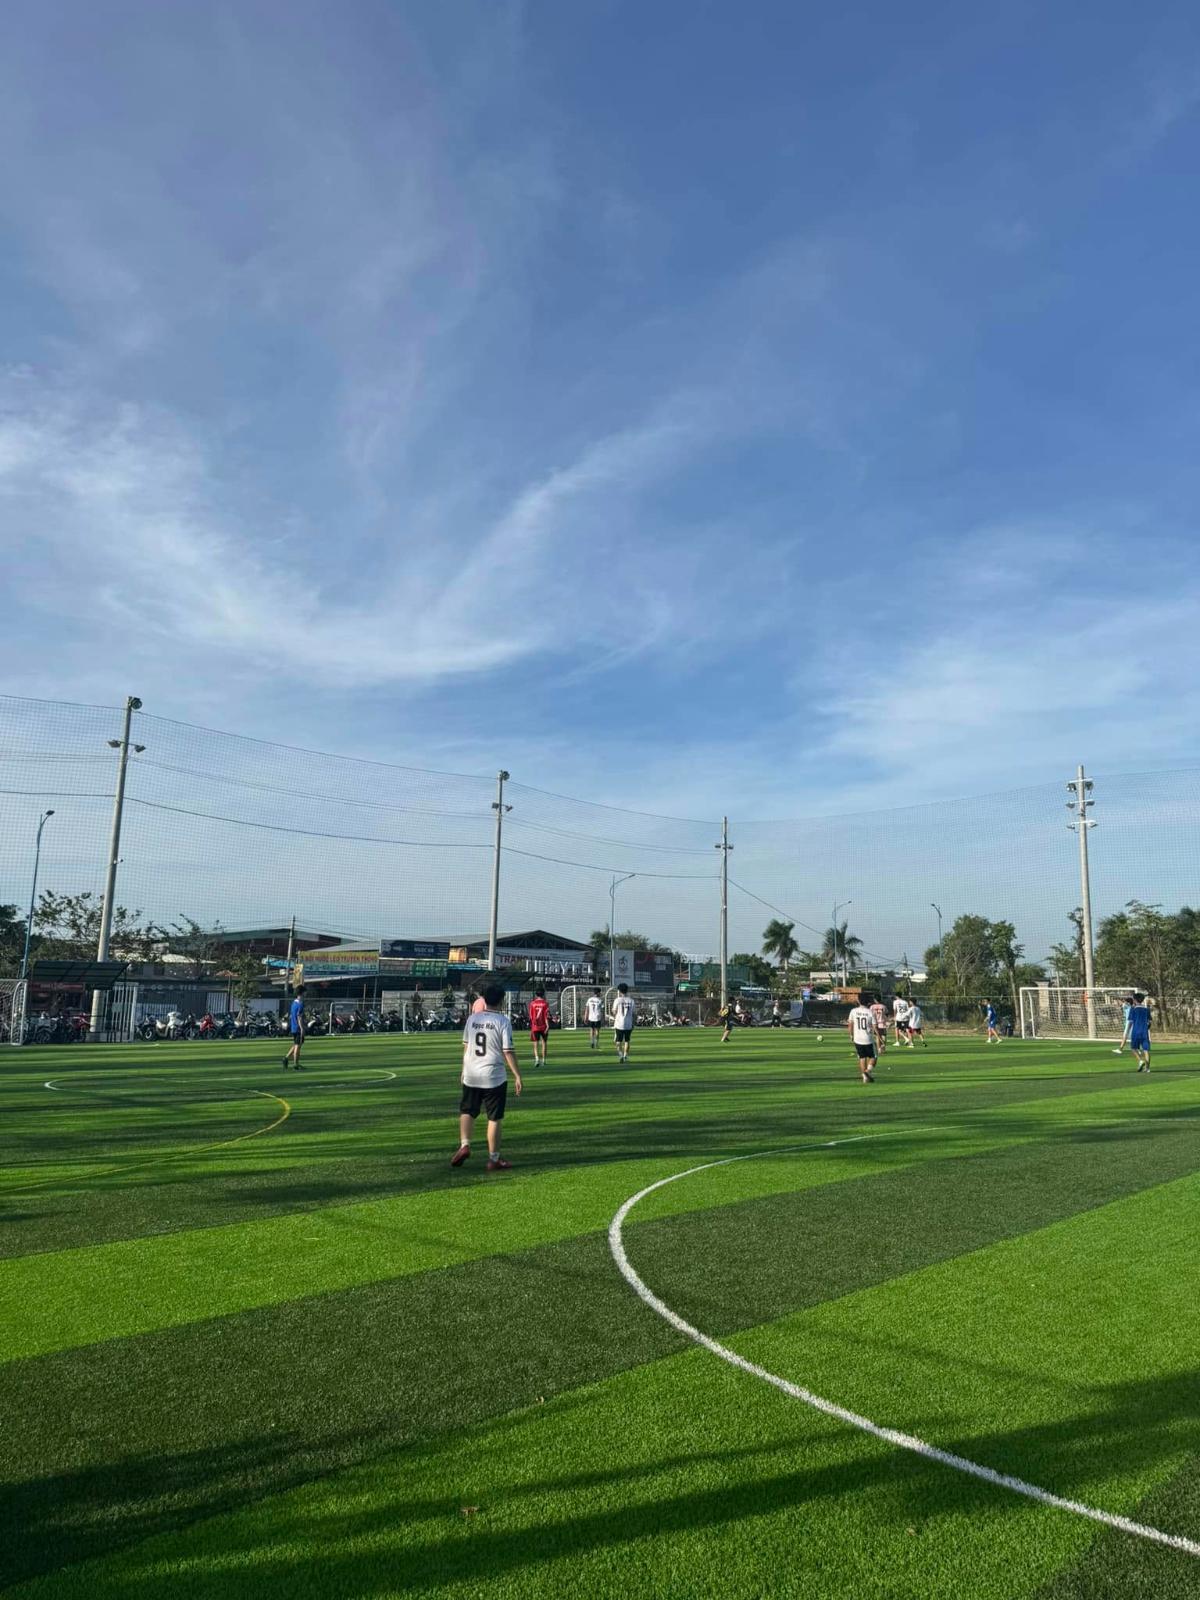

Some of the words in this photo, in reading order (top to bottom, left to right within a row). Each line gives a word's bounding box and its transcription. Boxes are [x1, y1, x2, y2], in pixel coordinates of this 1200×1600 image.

[535, 1007, 543, 1019] 7
[856, 1017, 867, 1030] 10
[475, 1032, 487, 1057] 9
